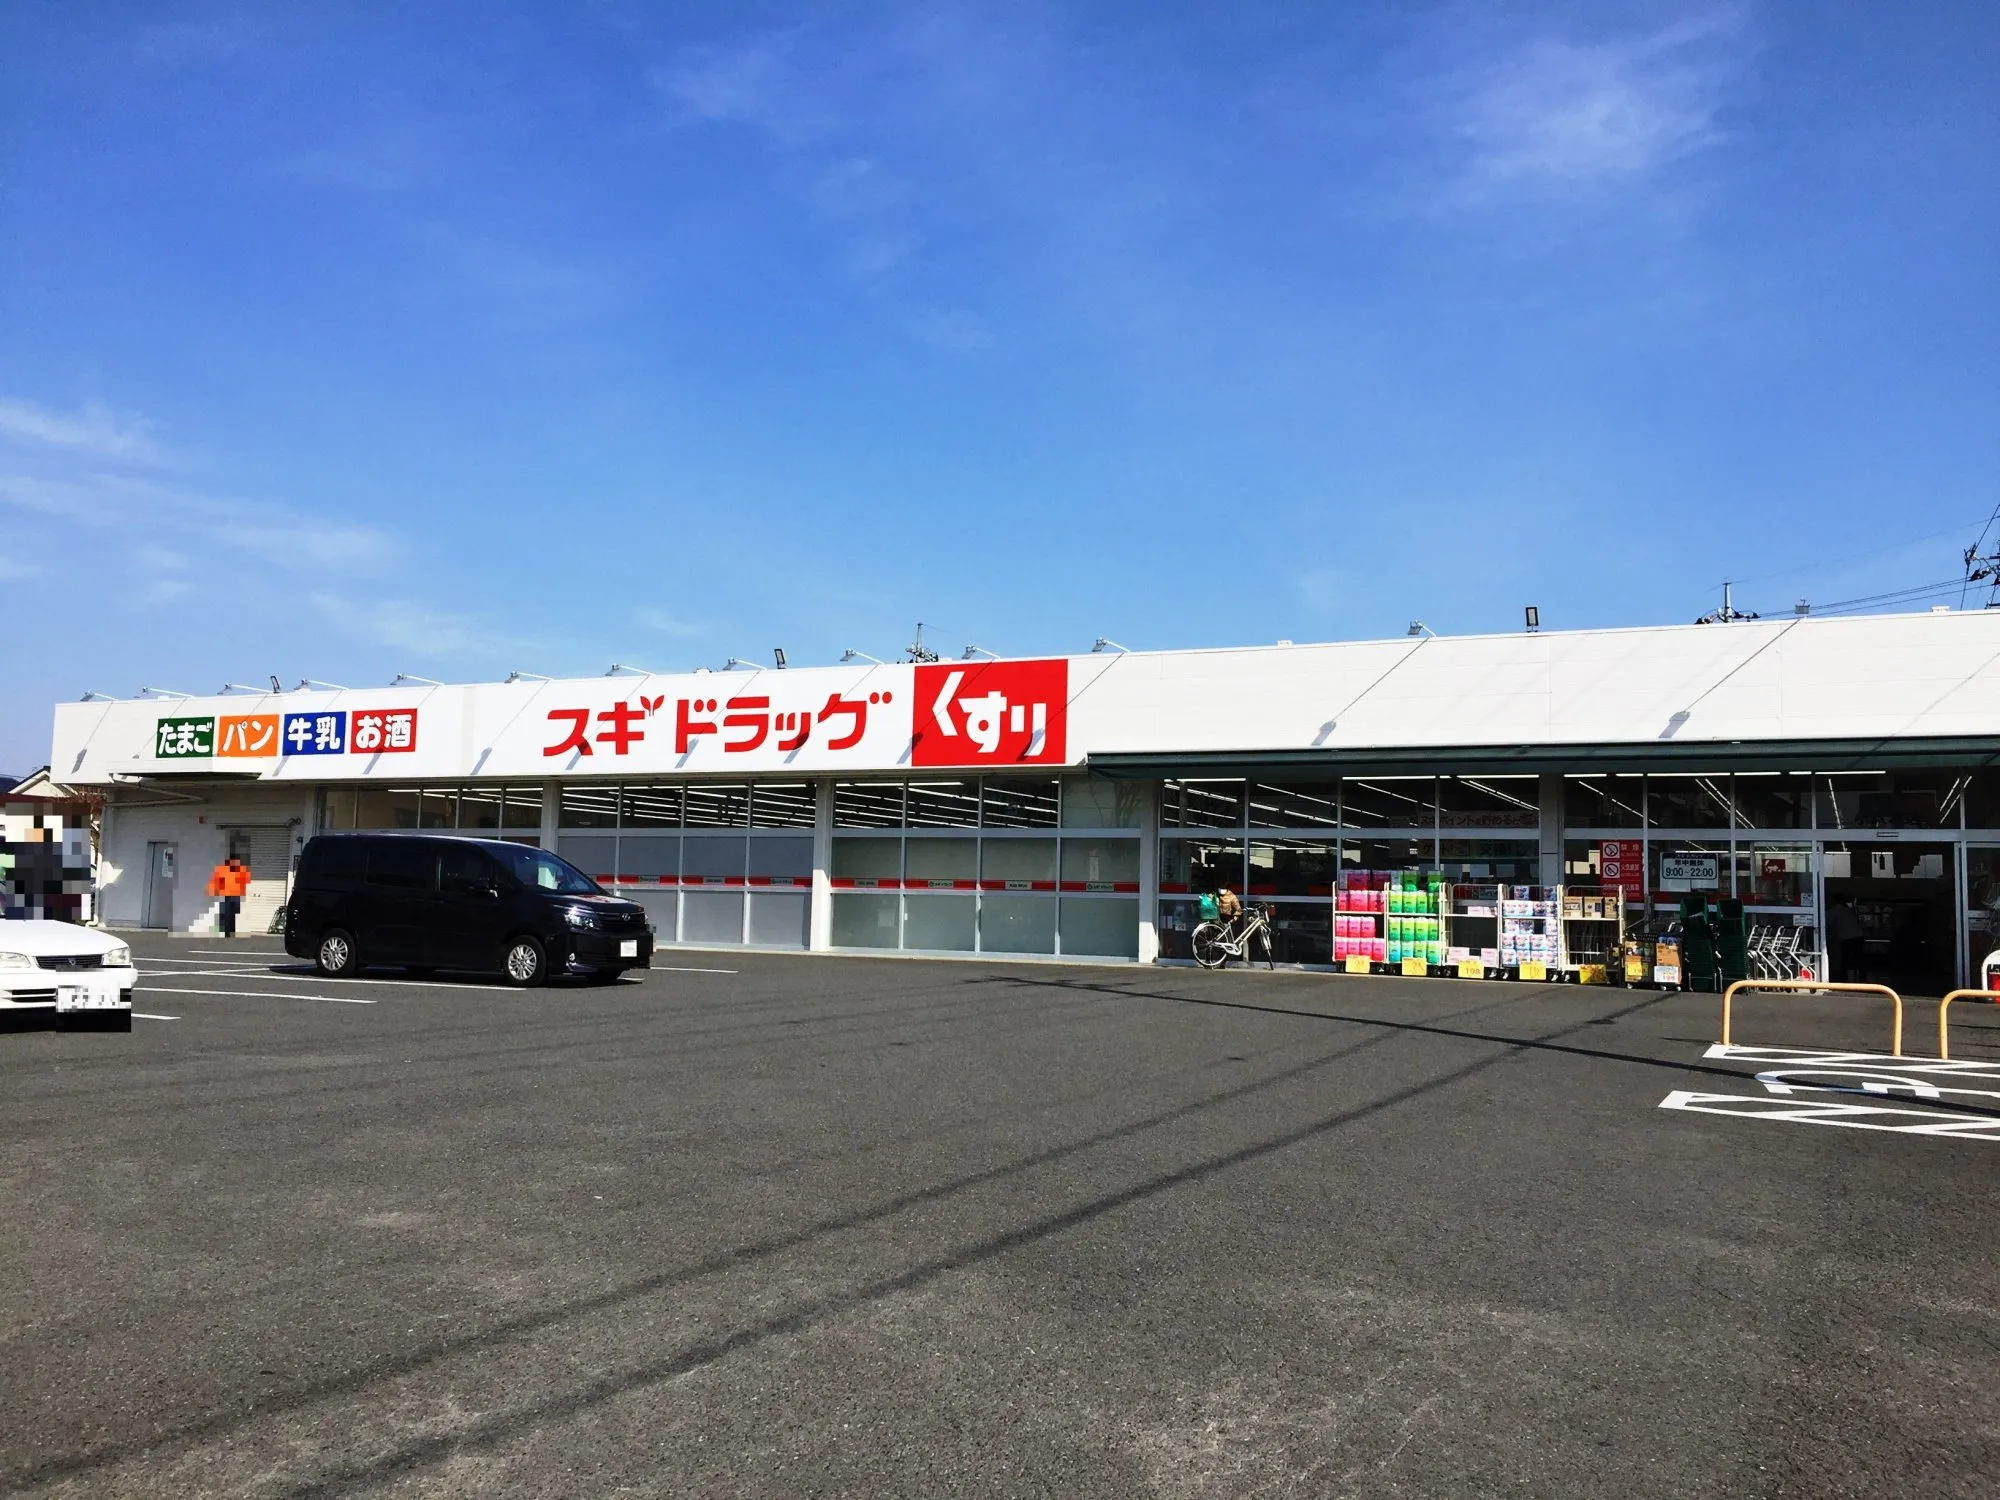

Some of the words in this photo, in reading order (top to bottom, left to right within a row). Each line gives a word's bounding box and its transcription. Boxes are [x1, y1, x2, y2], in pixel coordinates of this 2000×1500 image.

[355, 713, 412, 749] お酒
[931, 671, 1047, 757] くすり
[159, 722, 212, 754] たまご
[223, 719, 273, 752] パン
[287, 715, 341, 751] 牛乳
